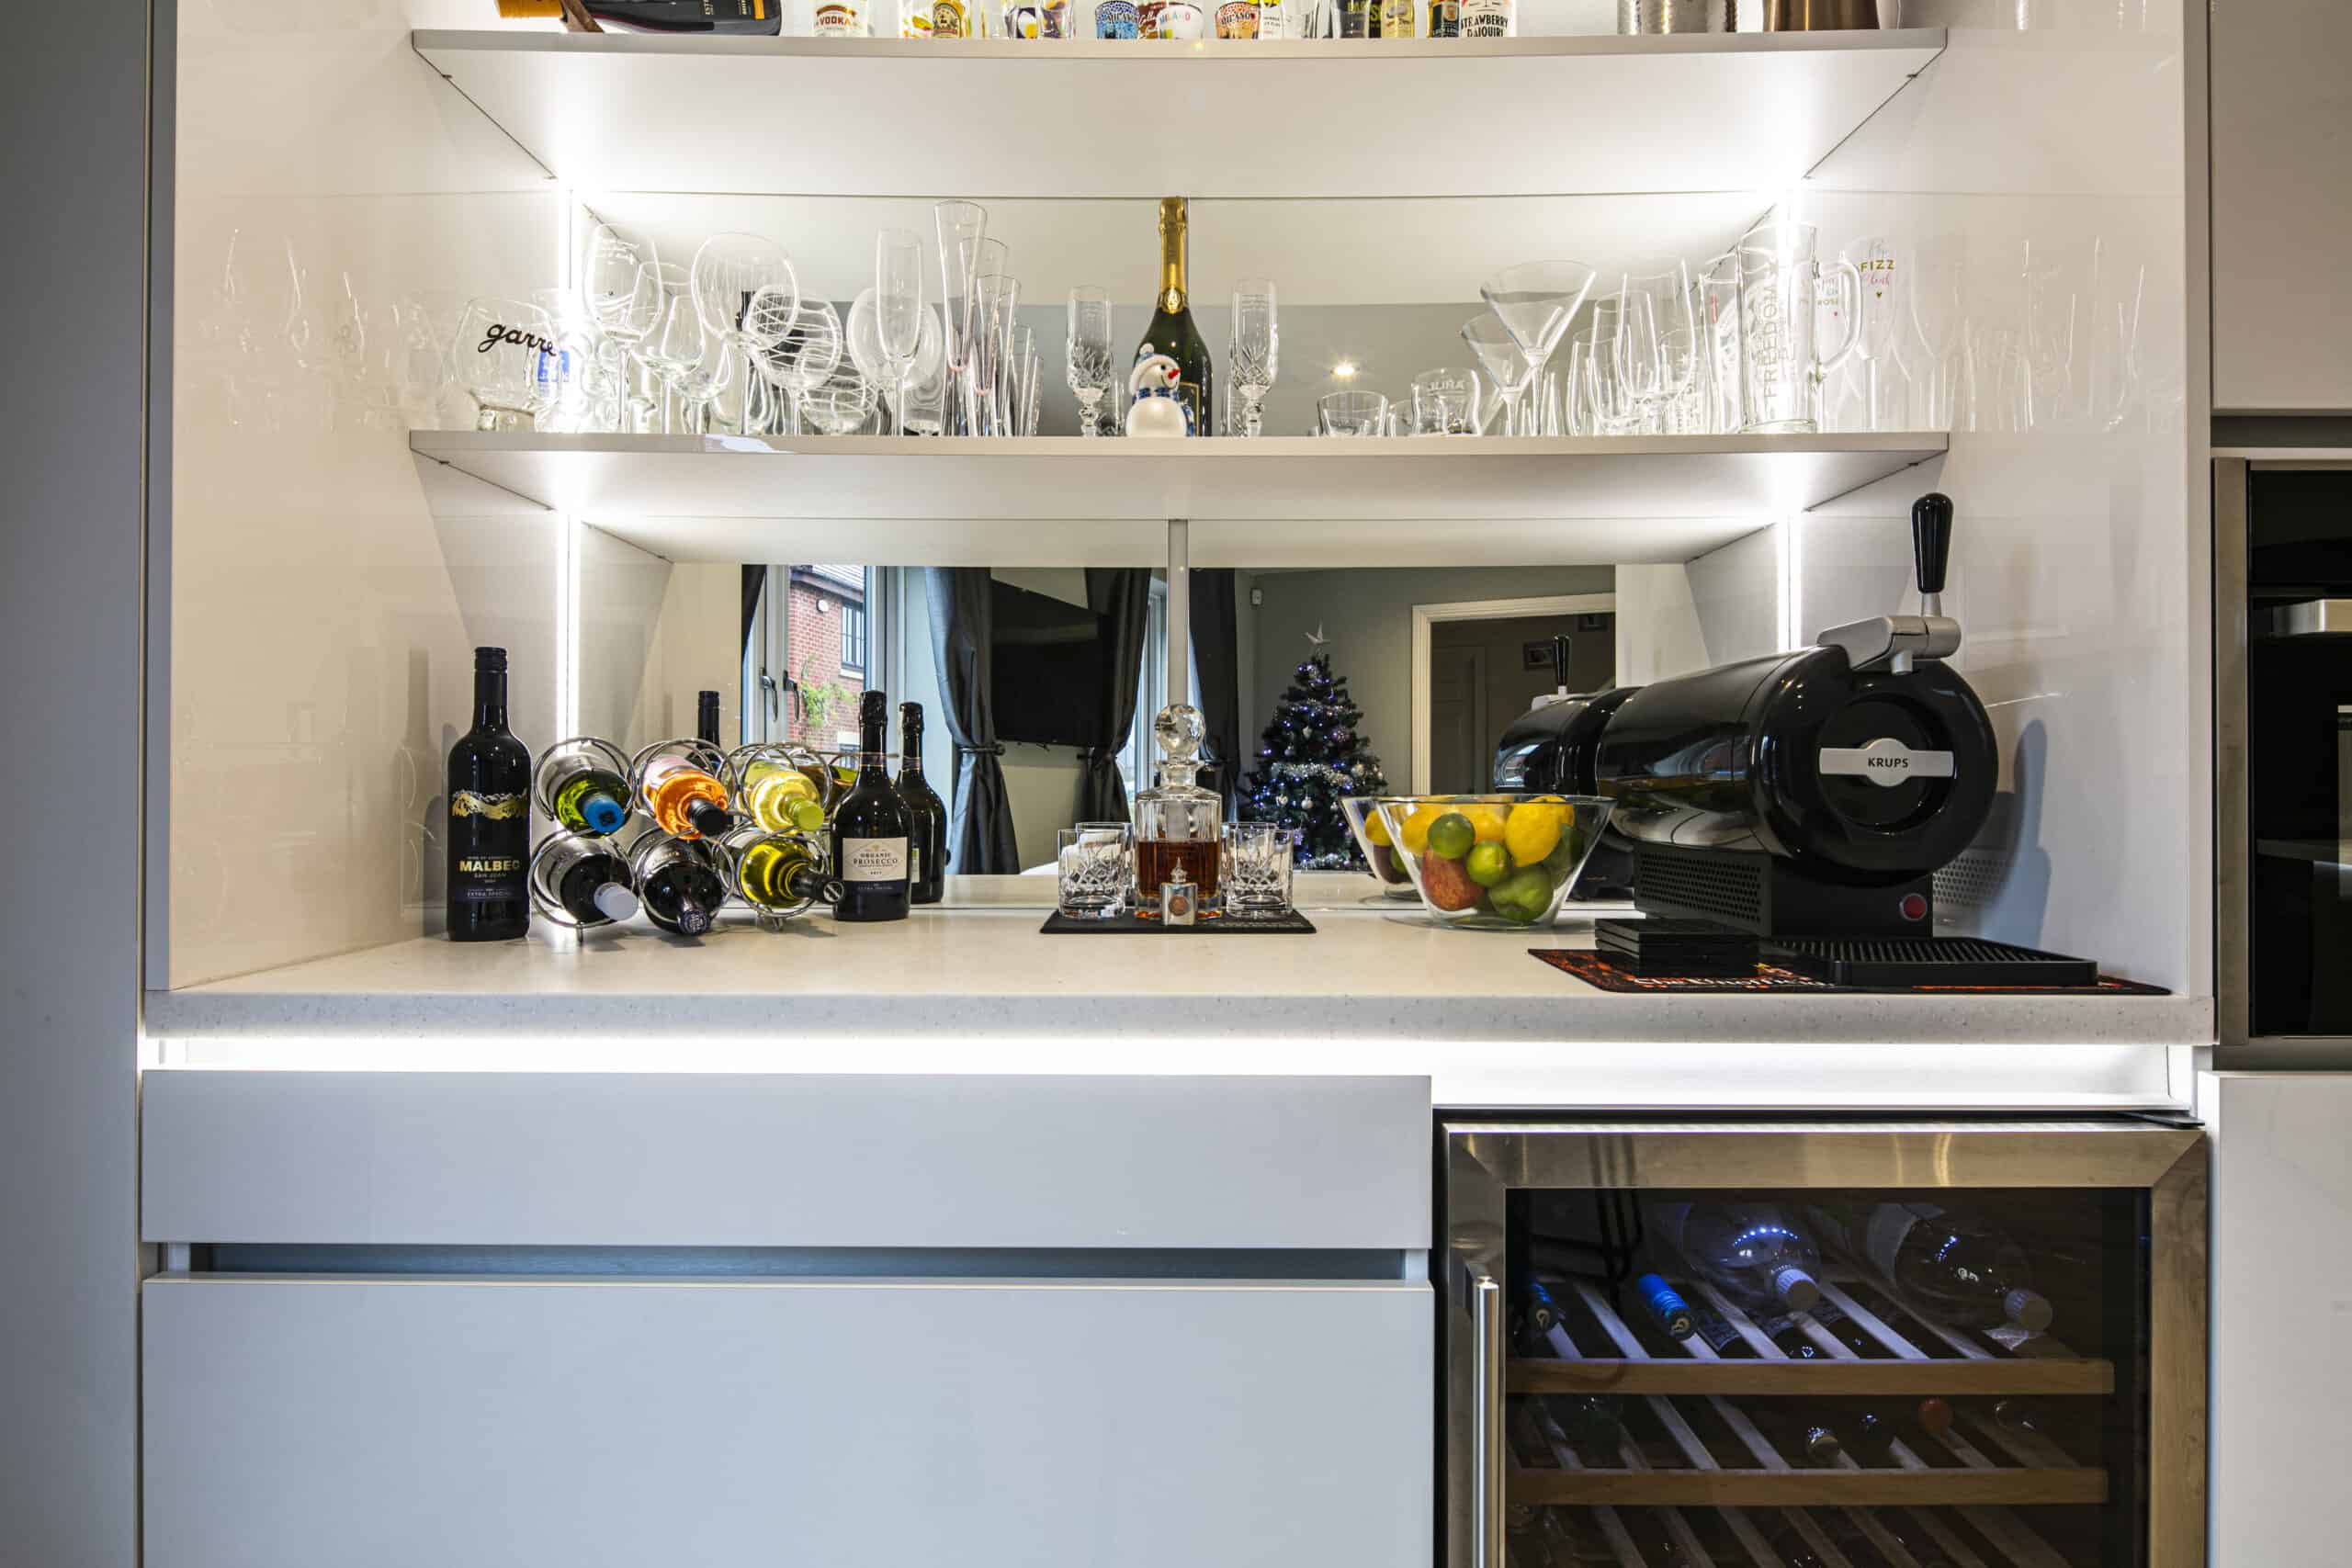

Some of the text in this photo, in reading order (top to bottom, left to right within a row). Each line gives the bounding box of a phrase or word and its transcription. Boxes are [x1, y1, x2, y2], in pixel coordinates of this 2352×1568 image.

[820, 16, 851, 26] VODKA
[1860, 259, 1894, 272] FIZZ
[1868, 757, 1908, 768] KRUPS
[459, 860, 520, 872] MALBEC
